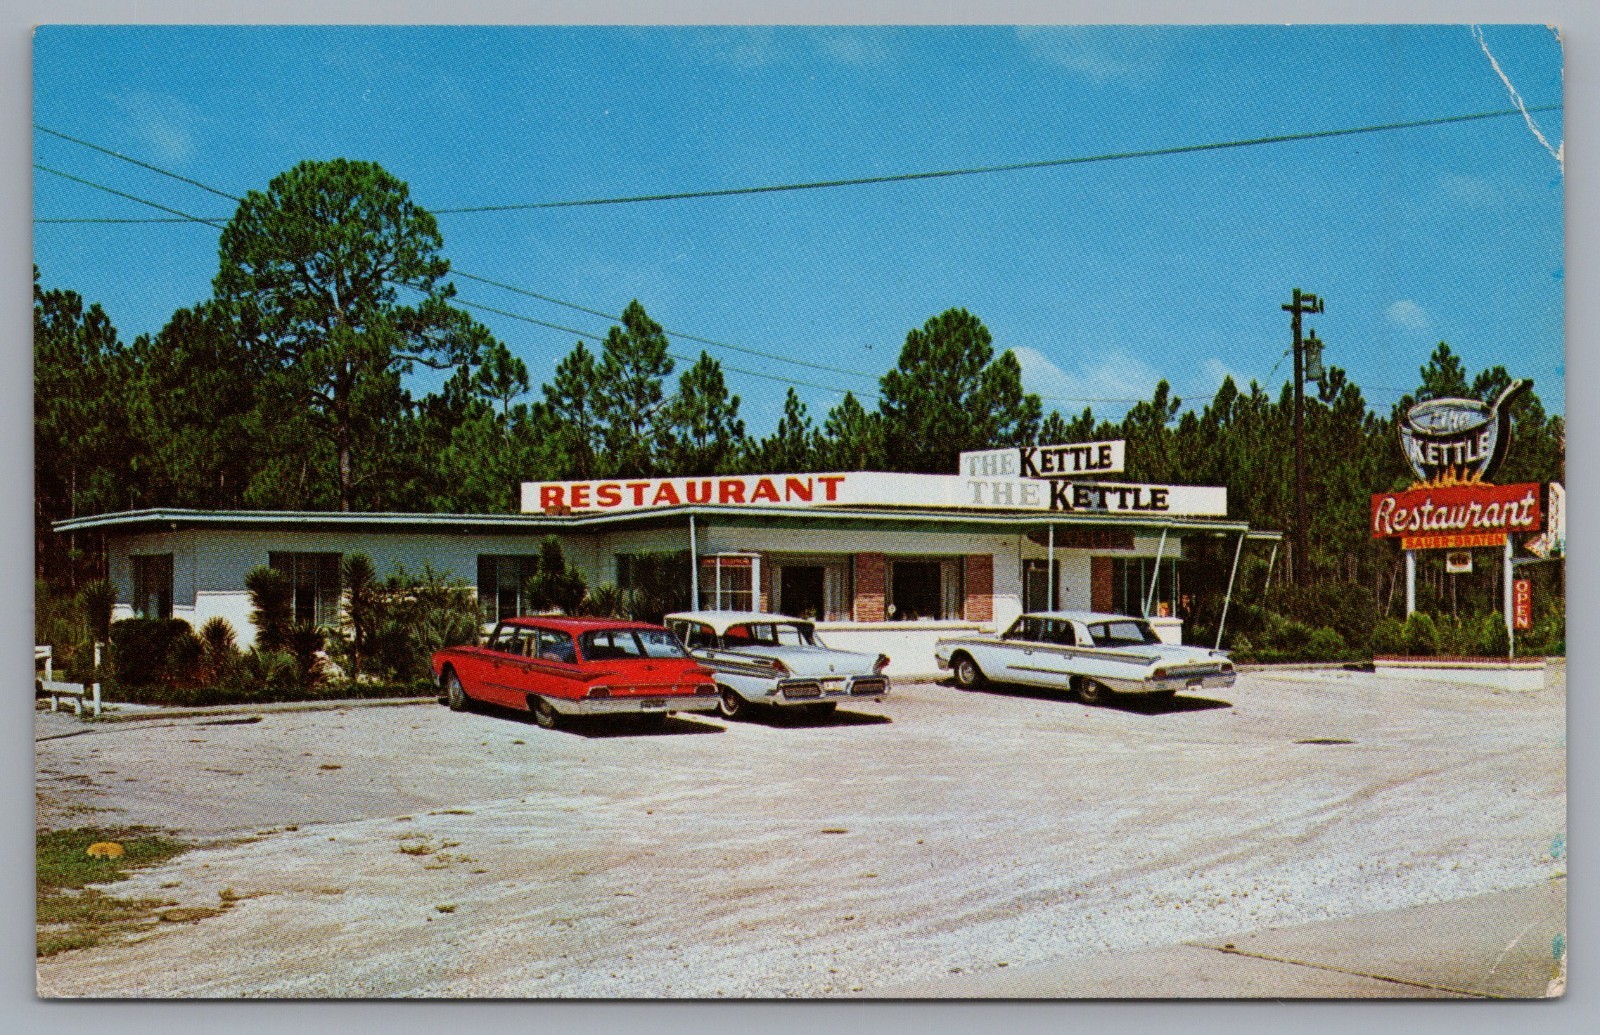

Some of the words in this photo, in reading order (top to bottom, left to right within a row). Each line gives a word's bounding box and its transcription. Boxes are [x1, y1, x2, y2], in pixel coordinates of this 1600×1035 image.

[965, 453, 1016, 477] THE
[1019, 444, 1113, 478] KETTLE
[1410, 431, 1490, 466] KETTLE
[539, 477, 846, 511] RESTAURANT
[967, 481, 1041, 506] THE
[1049, 480, 1169, 511] KETTLE
[1374, 489, 1536, 534] Restaurant
[1515, 581, 1528, 629] OPEN
